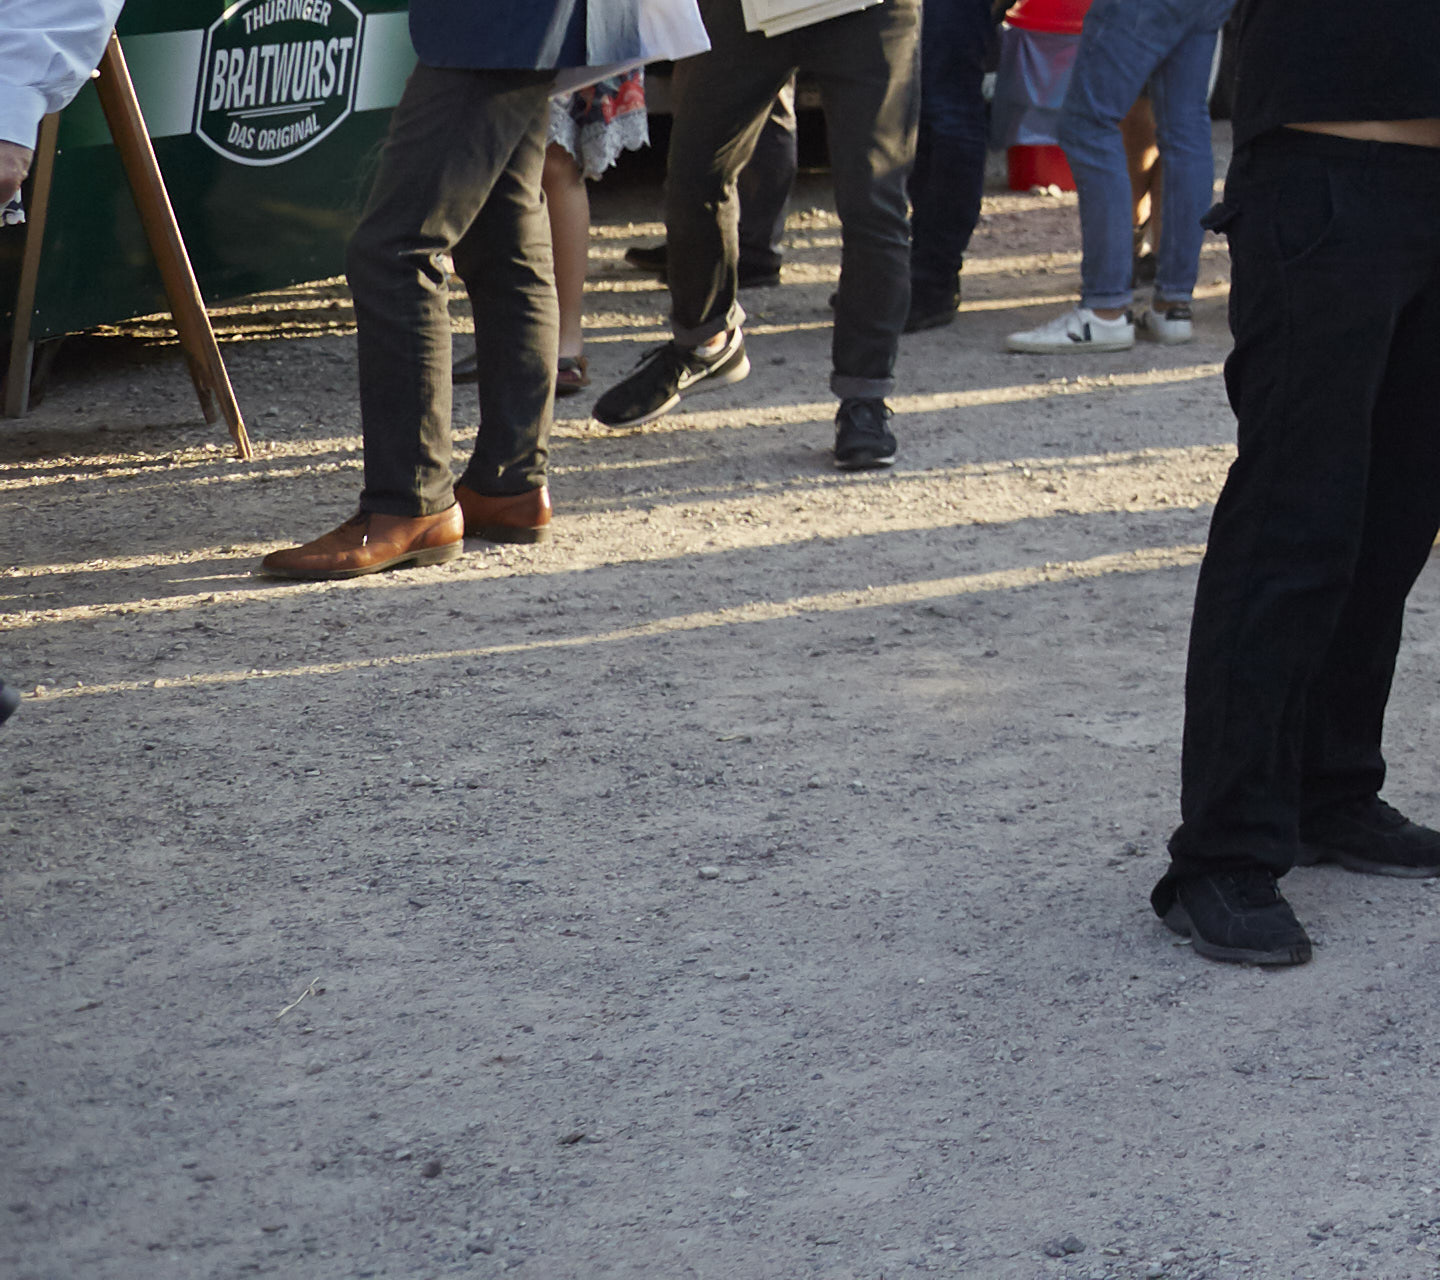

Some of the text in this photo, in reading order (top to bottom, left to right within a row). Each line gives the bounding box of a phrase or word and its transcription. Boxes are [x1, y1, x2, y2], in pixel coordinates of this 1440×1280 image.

[208, 37, 353, 111] BRATWURST
[227, 113, 321, 151] DAS ORIGINAL
